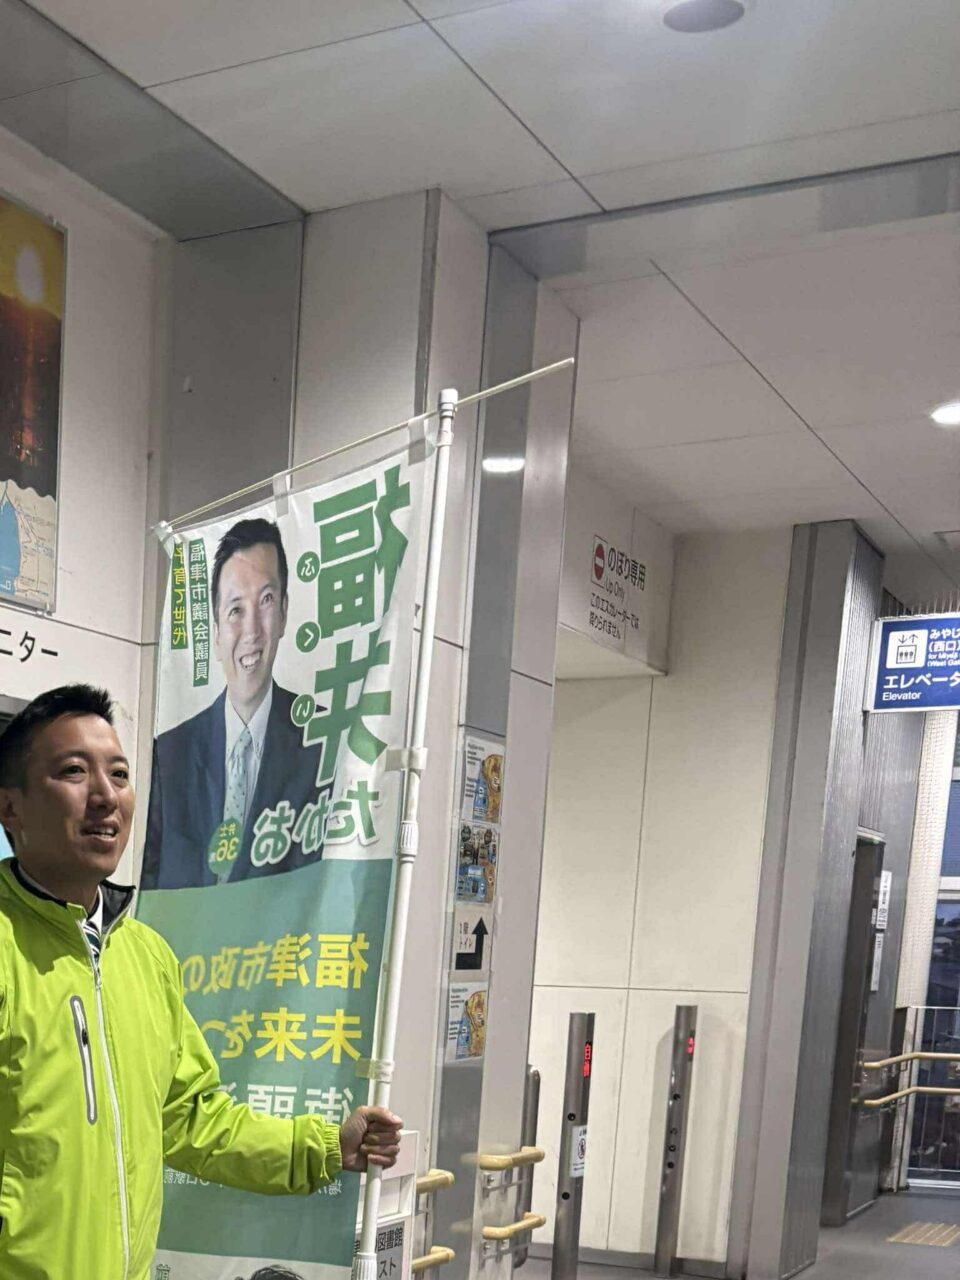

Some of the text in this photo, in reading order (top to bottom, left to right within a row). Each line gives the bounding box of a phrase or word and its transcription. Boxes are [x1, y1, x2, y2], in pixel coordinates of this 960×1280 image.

[607, 546, 646, 591] のぼり専用
[882, 691, 922, 701] Elevator
